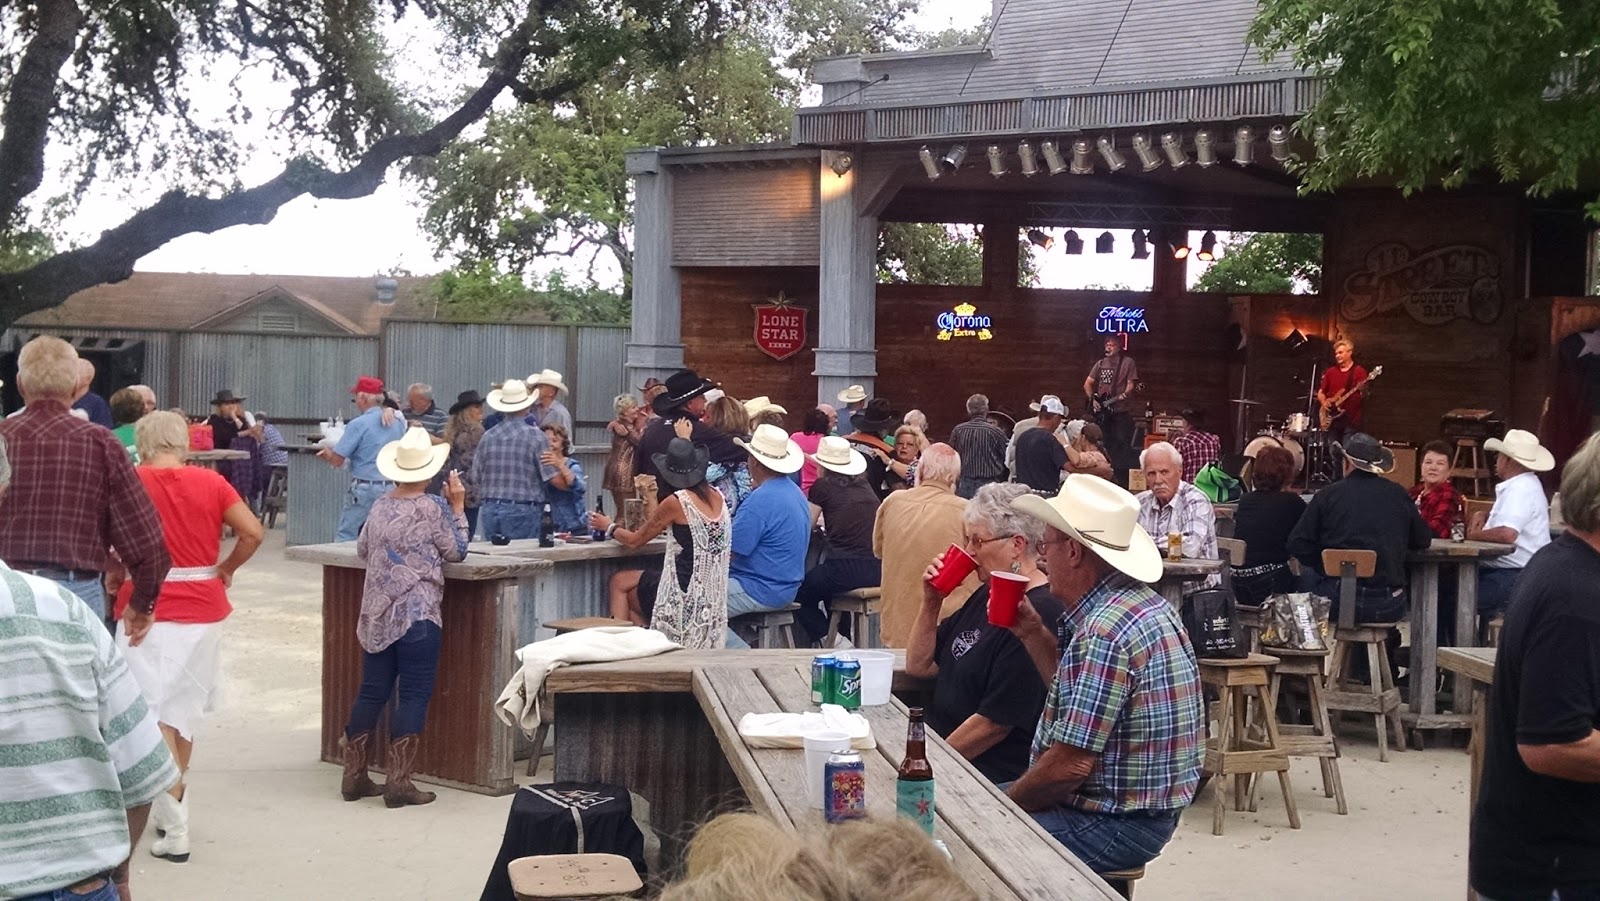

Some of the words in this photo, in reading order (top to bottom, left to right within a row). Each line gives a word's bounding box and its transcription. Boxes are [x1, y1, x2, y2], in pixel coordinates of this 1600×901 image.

[1410, 291, 1466, 304] COWBOY
[1423, 304, 1457, 317] BAR
[762, 315, 799, 327] LONE
[937, 312, 991, 331] Corona
[1095, 318, 1149, 332] ULTRA
[762, 328, 799, 340] STAR
[954, 328, 976, 337] Extra
